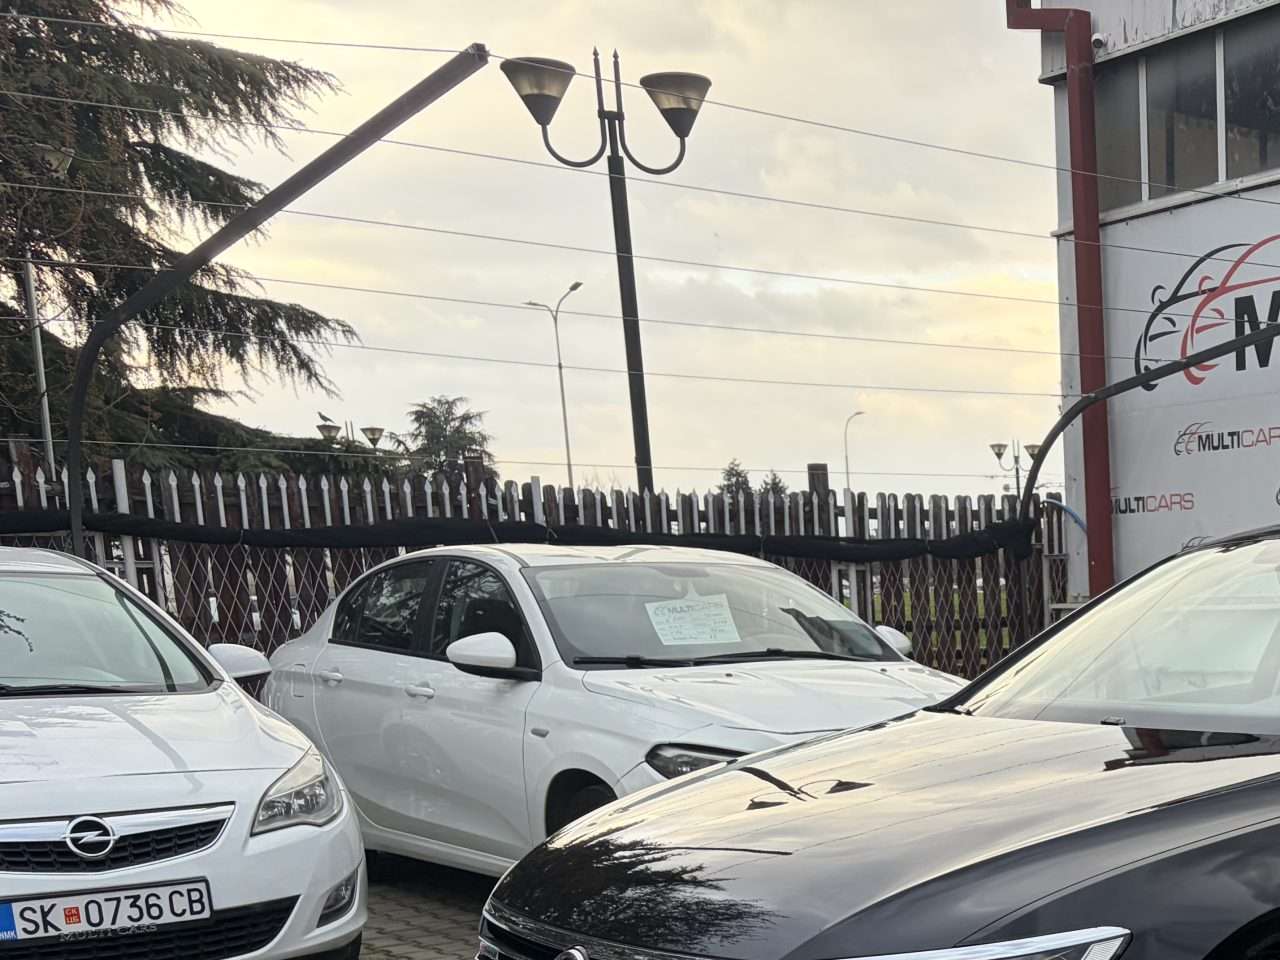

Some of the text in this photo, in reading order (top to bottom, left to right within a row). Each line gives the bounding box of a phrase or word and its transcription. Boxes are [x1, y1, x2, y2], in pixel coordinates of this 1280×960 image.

[19, 887, 207, 936] SK 0736 CB
